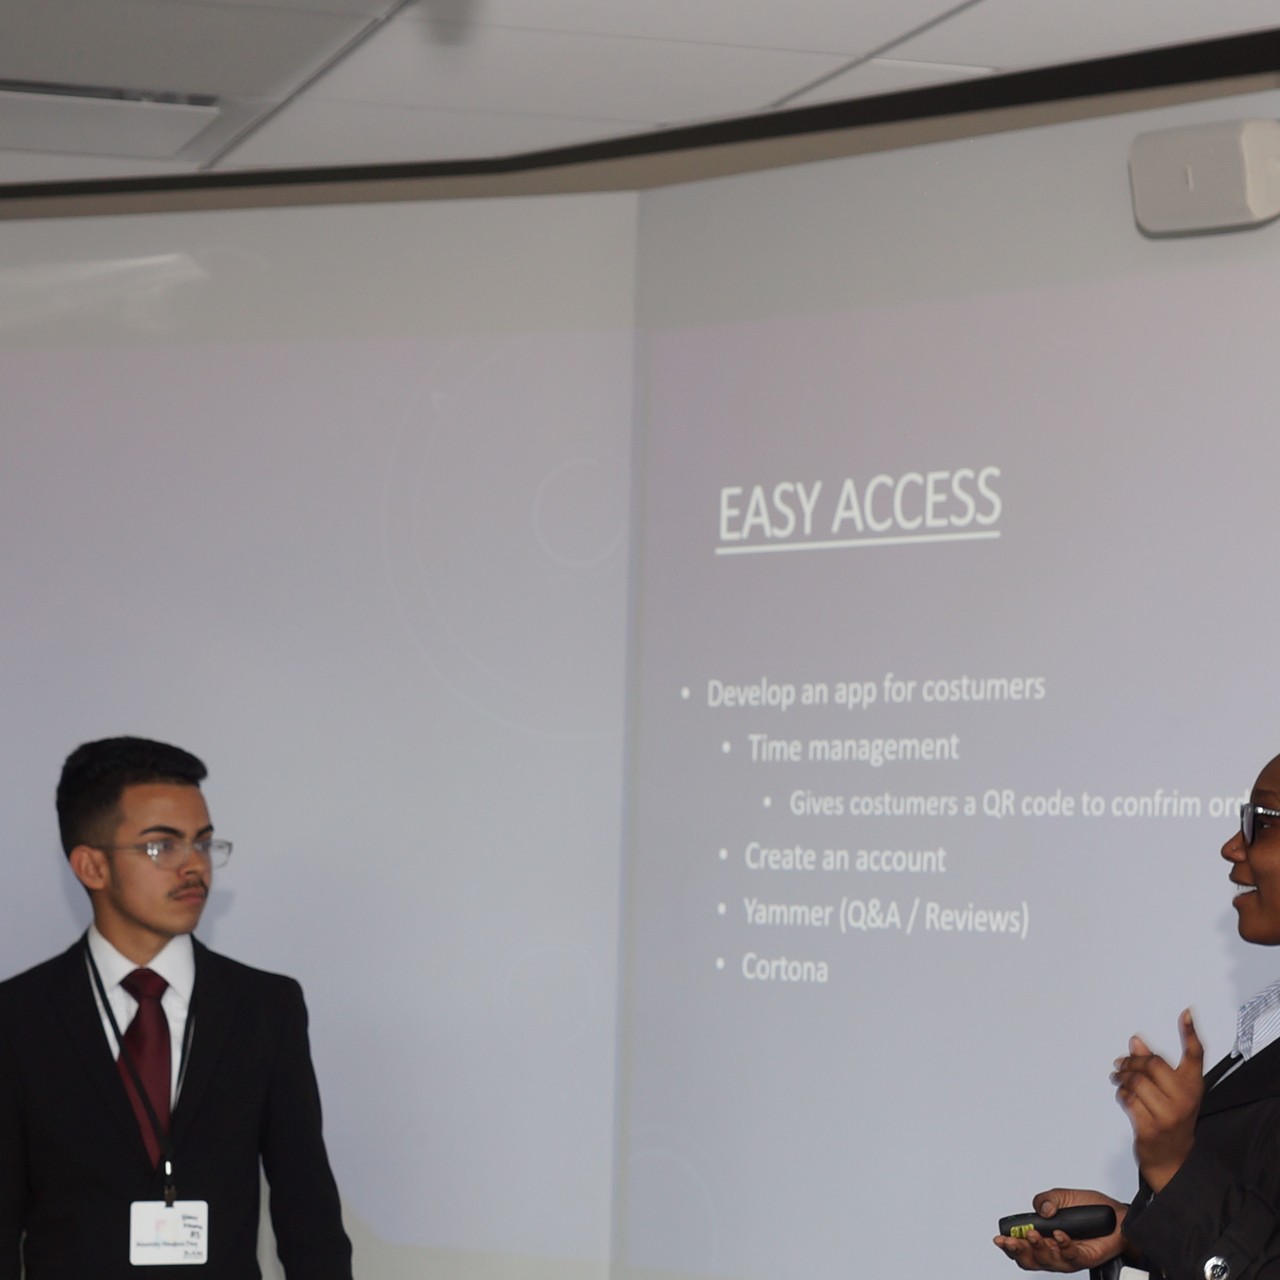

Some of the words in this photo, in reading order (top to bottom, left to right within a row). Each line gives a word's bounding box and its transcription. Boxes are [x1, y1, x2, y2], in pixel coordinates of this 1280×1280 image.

[719, 480, 823, 541] EASY
[831, 465, 1003, 534] ACCESS
[707, 676, 796, 712] Develop
[800, 682, 829, 705] an
[834, 681, 878, 710] app
[883, 672, 917, 703] for
[922, 675, 1046, 702] costumers
[747, 733, 803, 762] Time
[808, 733, 960, 768] management
[789, 789, 845, 816] Gives
[849, 792, 959, 817] costumers
[963, 795, 977, 817] a
[982, 788, 1015, 819] QR
[1020, 788, 1076, 817] code
[1081, 791, 1106, 817] to
[1111, 788, 1202, 818] confrim
[744, 841, 817, 871] Create
[821, 849, 850, 871] an
[855, 846, 947, 873] account
[743, 897, 834, 927] Yammer
[839, 897, 902, 934] (Q&A
[905, 897, 920, 935] /
[925, 901, 1029, 940] Reviews)
[741, 951, 829, 983] Cortona
